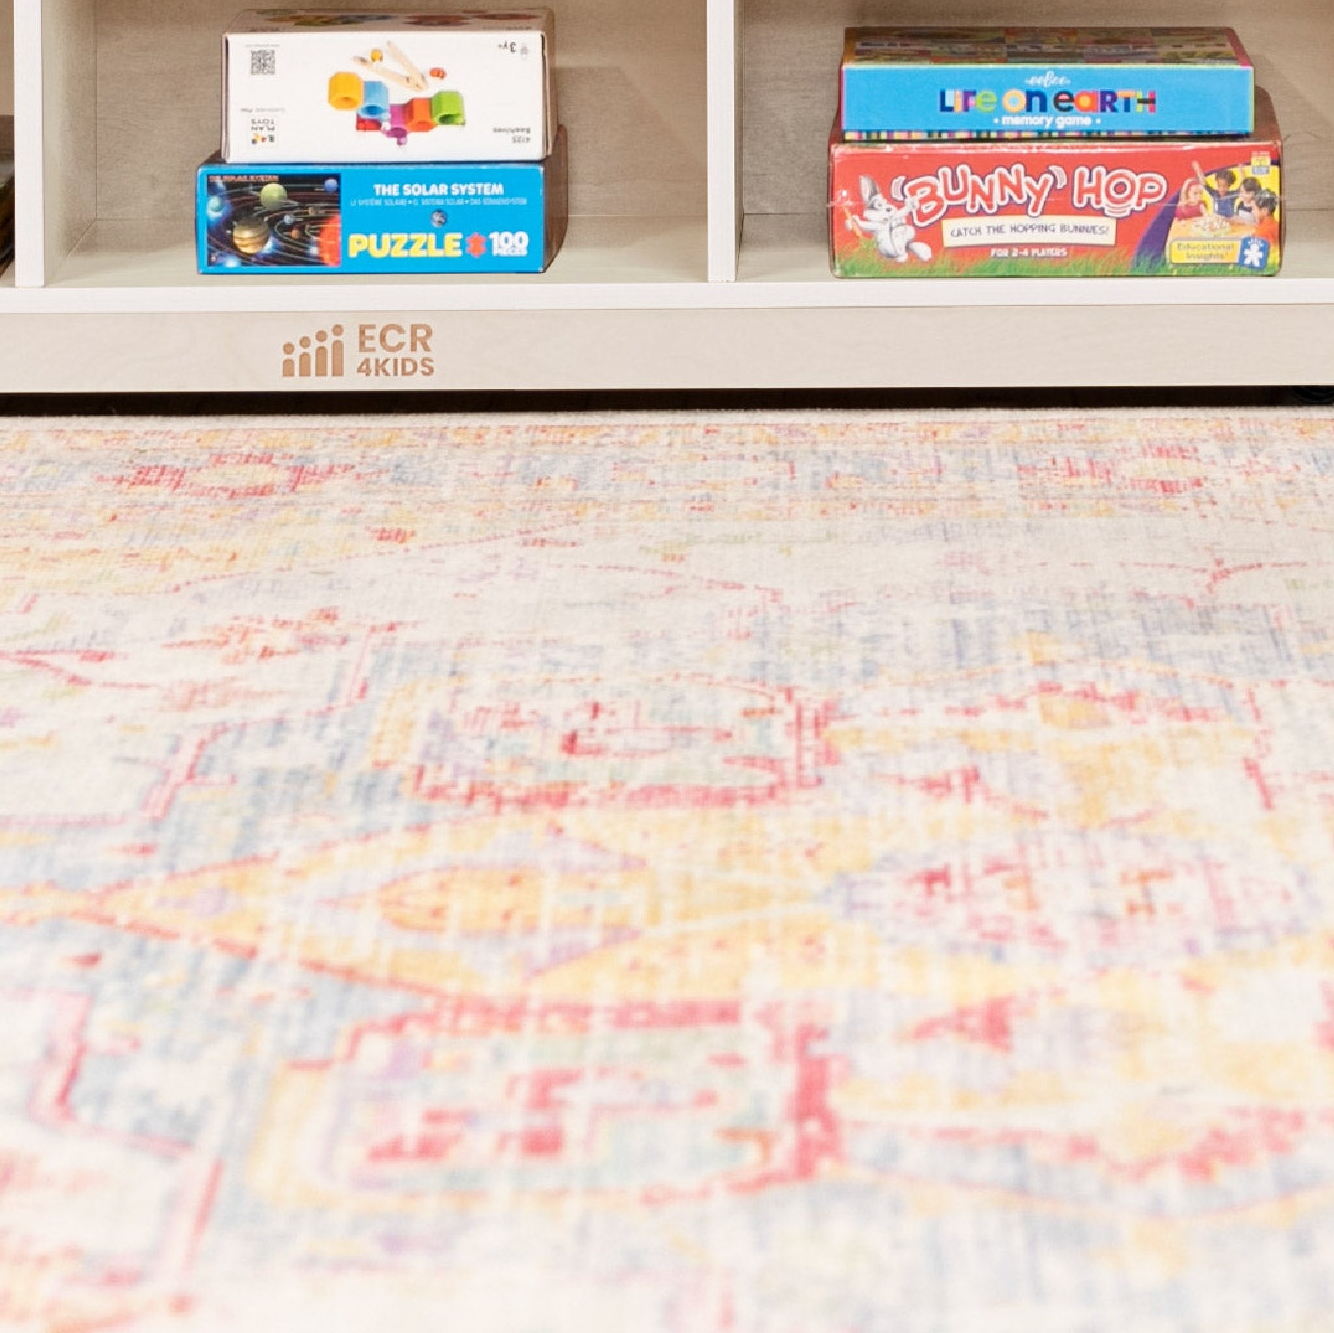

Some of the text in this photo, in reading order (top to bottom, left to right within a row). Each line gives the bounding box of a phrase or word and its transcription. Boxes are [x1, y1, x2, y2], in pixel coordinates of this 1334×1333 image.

[1001, 115, 1092, 130] memory game
[373, 182, 505, 196] THE SOLAR SYSTEM
[904, 163, 1167, 227] BUNNY HOP
[950, 225, 983, 238] CATCH
[986, 224, 1005, 234] THE
[1010, 223, 1055, 234] HOPPING
[348, 232, 464, 259] PUZZLE
[489, 230, 530, 250] 100
[990, 247, 1009, 258] FOR
[358, 323, 434, 353] ECR
[356, 356, 435, 377] 4KIDS
